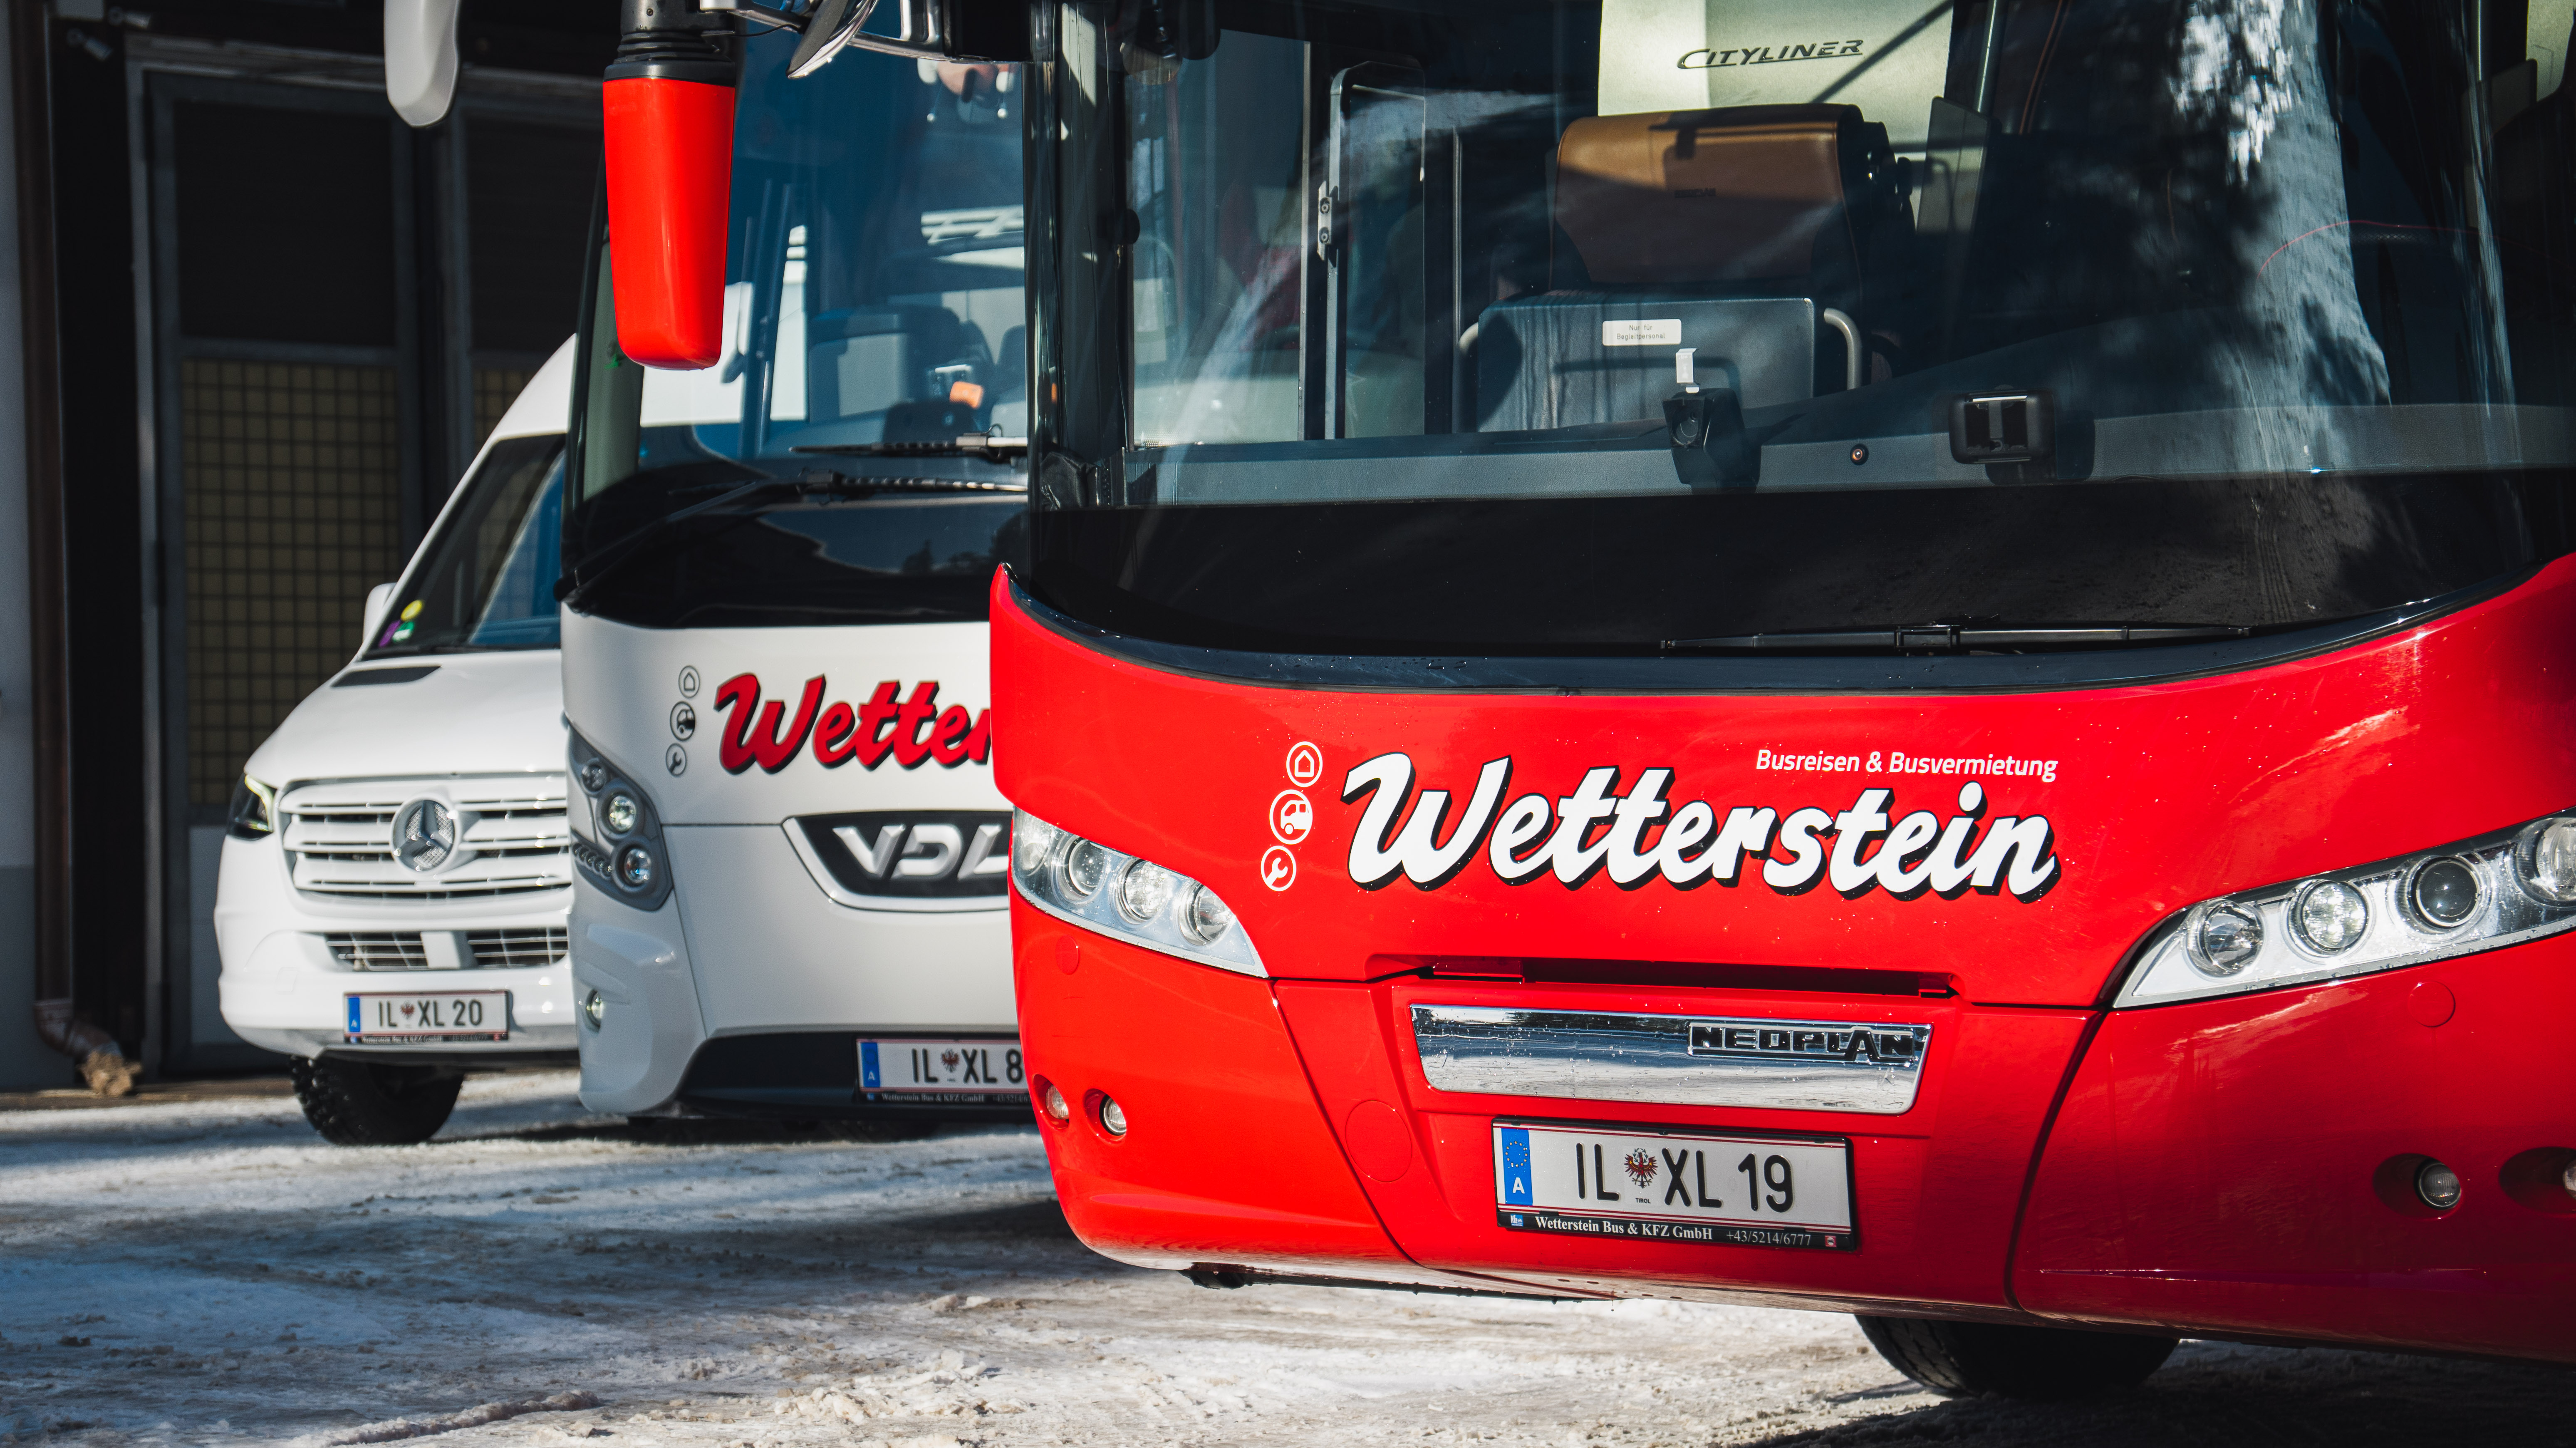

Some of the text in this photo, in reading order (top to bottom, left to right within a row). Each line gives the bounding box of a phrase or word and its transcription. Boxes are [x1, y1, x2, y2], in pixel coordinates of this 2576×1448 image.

[1677, 40, 1864, 69] CITYLINER
[1756, 749, 2058, 783] Busreisen & Busvermietung
[1340, 752, 2062, 904] Wetterstein
[833, 825, 1009, 881] VDL
[351, 1019, 357, 1028] A
[378, 999, 482, 1027] IL XL 20
[1692, 1026, 1914, 1062] NEOPLAN
[868, 1071, 875, 1081] A
[912, 1049, 1022, 1084] IL XL 8
[1512, 1178, 1525, 1193] A
[1576, 1143, 1794, 1212] IL XL 19
[1535, 1217, 1811, 1245] Wetterstein Bus & KFZ GmbH +43/5214/6777
